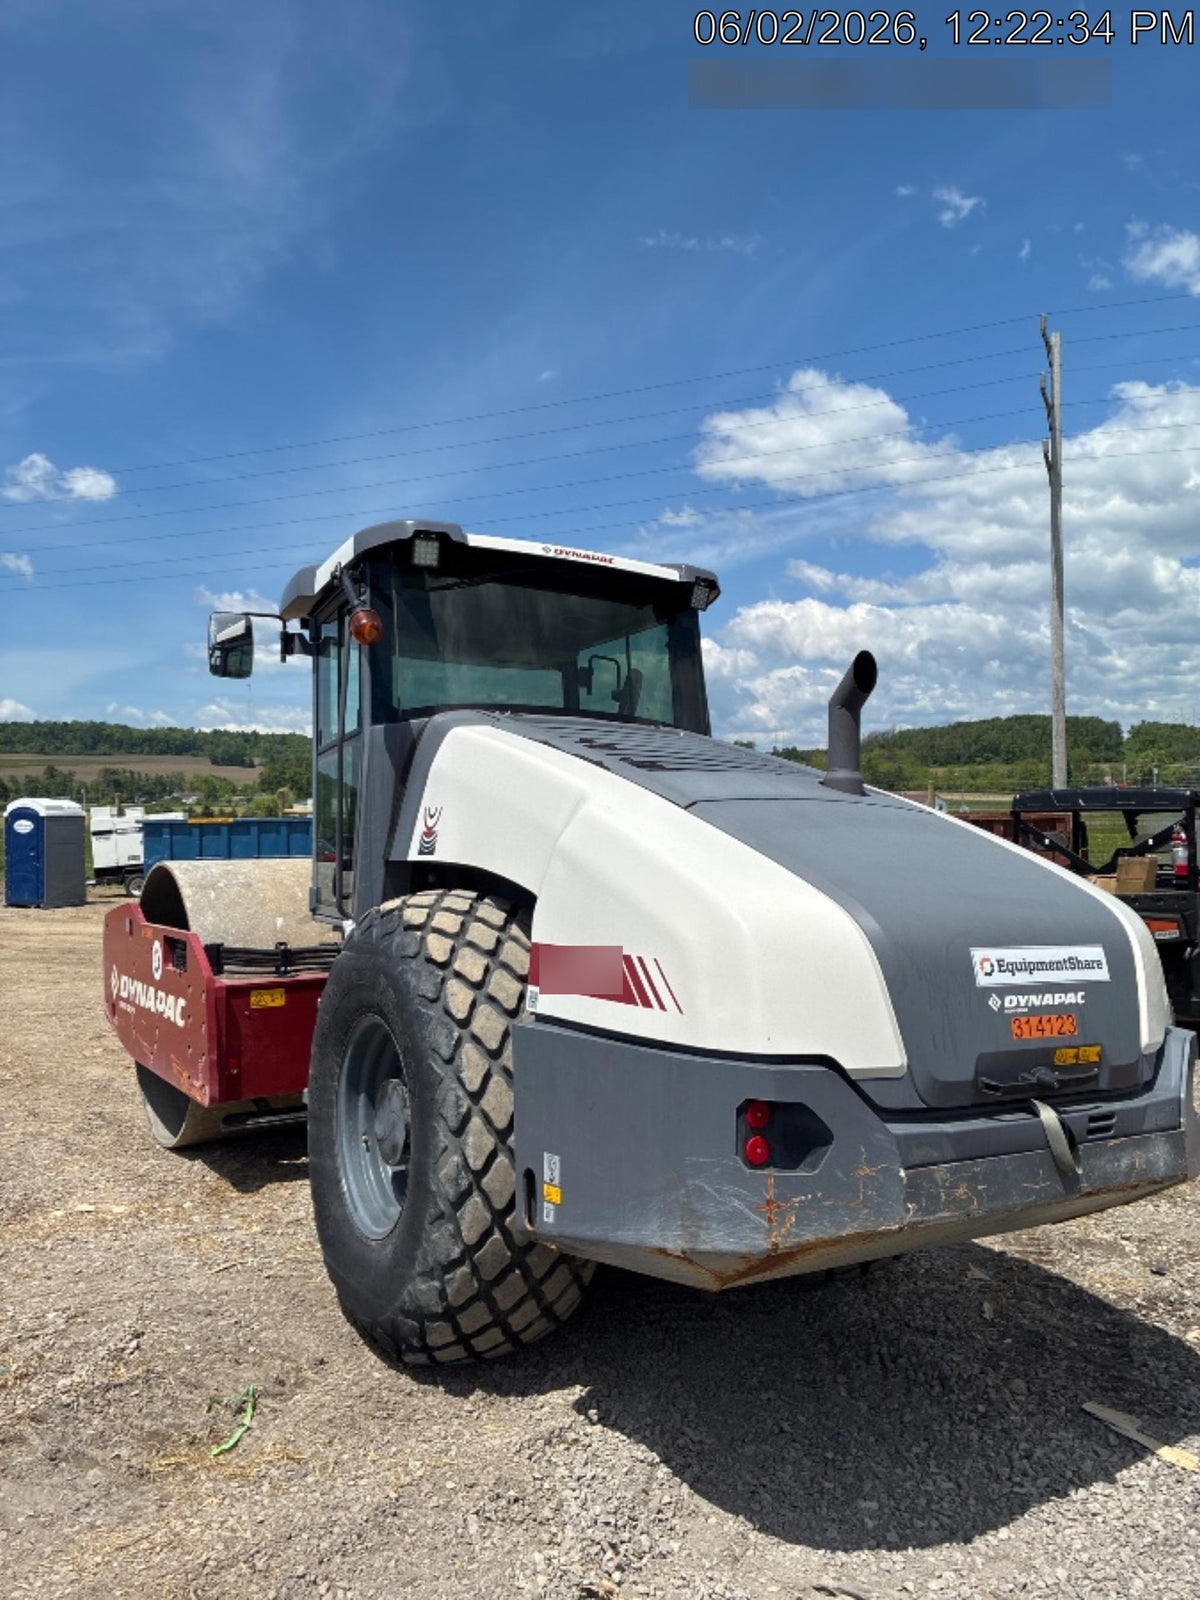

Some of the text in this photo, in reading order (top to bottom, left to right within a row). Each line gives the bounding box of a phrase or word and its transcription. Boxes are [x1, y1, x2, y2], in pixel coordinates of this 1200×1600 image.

[553, 548, 615, 565] DYNAPAC
[996, 956, 1104, 977] EquipmentShare
[119, 975, 187, 1028] DYNAPAC
[1004, 991, 1086, 1008] DYNAPAC
[1012, 1015, 1077, 1039] 314123
